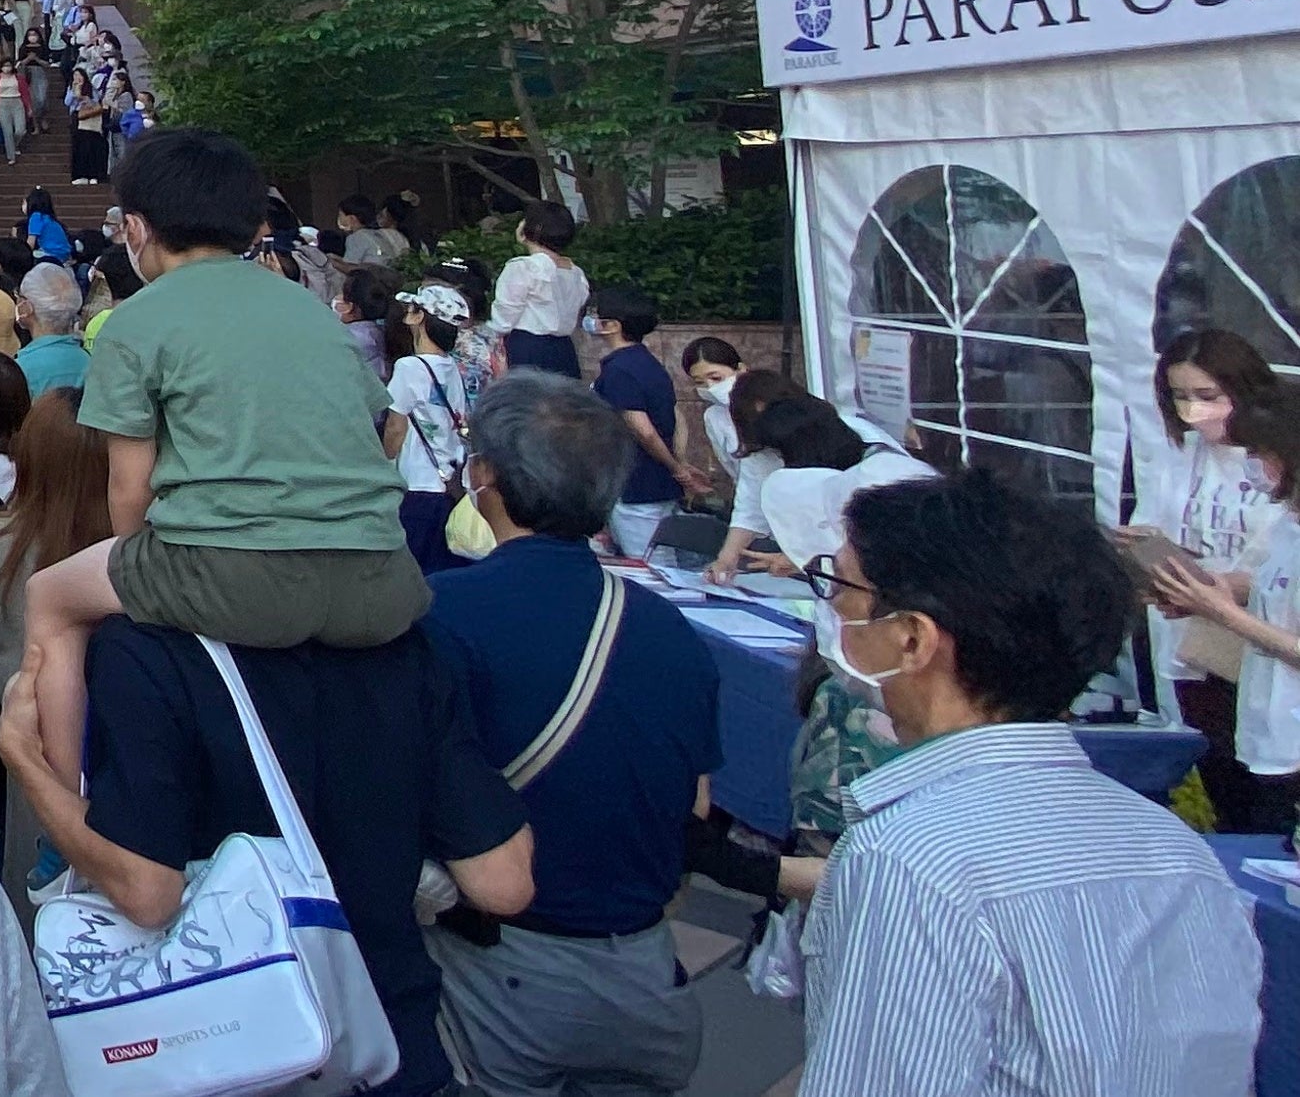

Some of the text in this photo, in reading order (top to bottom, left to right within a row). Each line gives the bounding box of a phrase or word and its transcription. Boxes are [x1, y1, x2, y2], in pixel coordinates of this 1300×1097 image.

[106, 1019, 242, 1061] KONAMI SPORTS CLUB
